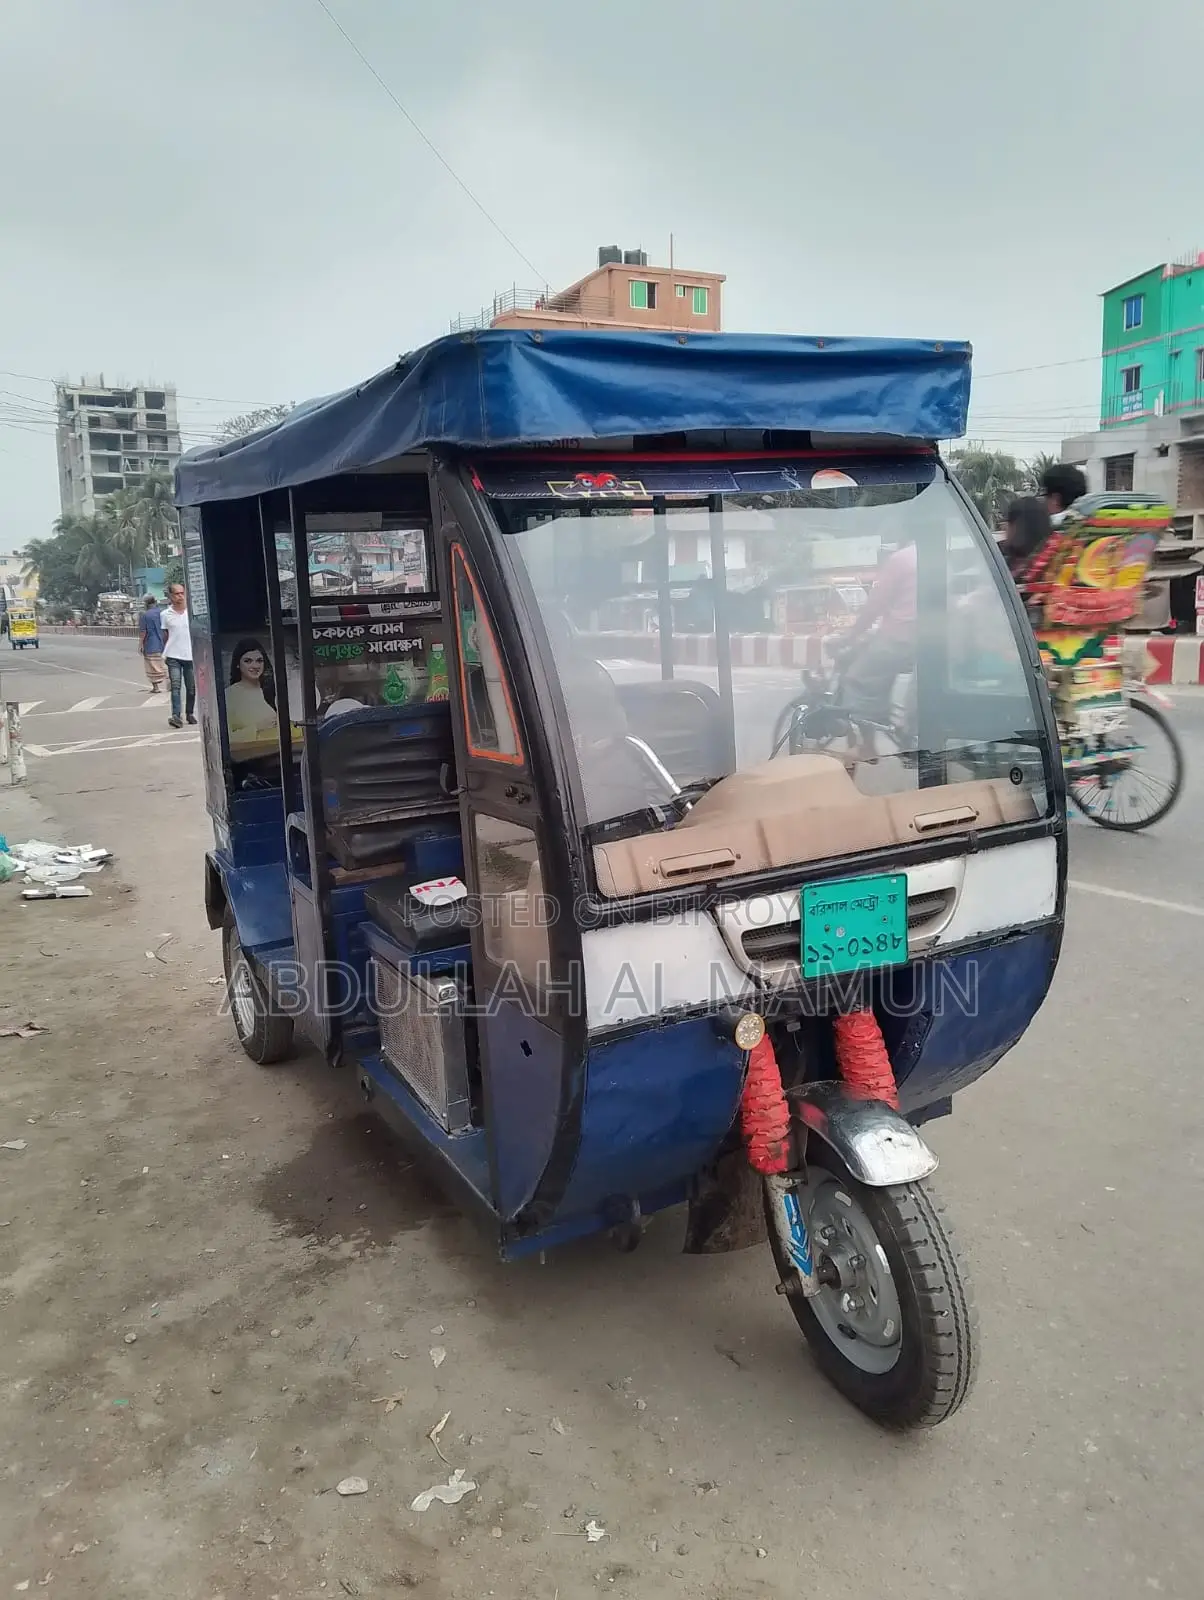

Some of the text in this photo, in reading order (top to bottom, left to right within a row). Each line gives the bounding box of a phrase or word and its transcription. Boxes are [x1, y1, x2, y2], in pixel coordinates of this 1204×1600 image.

[369, 621, 404, 636] বাসন
[367, 638, 423, 654] সারাক্ষণ
[808, 899, 849, 917] বরিশাল
[807, 933, 903, 963] ১১-০১৪৮
